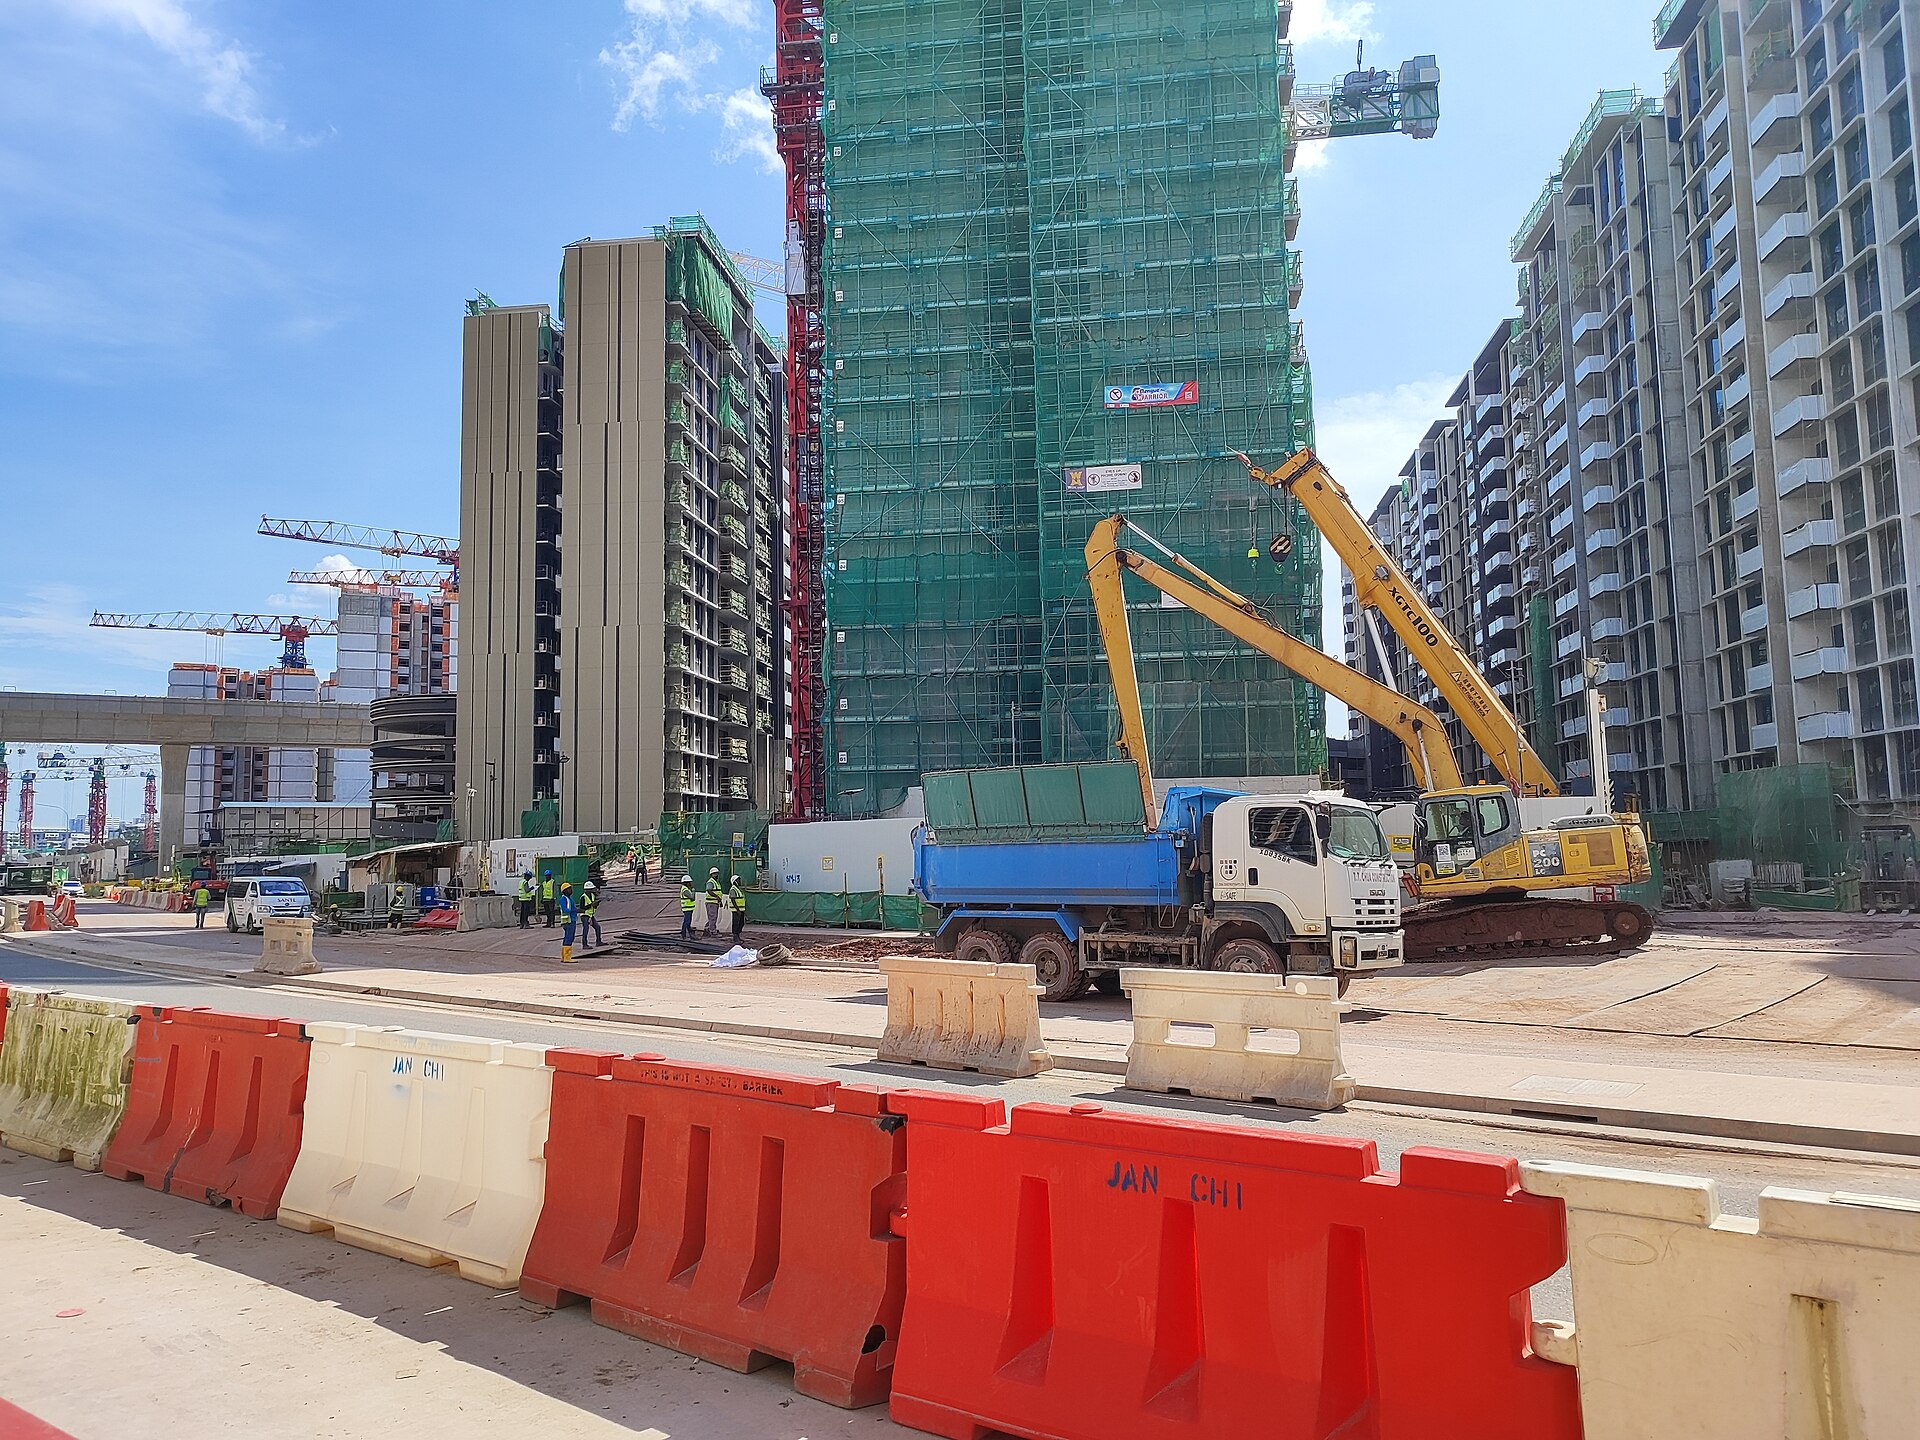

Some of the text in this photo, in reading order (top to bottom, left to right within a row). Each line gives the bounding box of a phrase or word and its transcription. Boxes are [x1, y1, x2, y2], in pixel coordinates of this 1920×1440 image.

[1387, 586, 1439, 647] XGTC100
[1532, 849, 1546, 858] PC
[1533, 856, 1560, 868] 200
[392, 1056, 444, 1082] JAN CHI
[742, 1080, 783, 1096] BARRIER
[1107, 1161, 1242, 1210] JAN CHI
